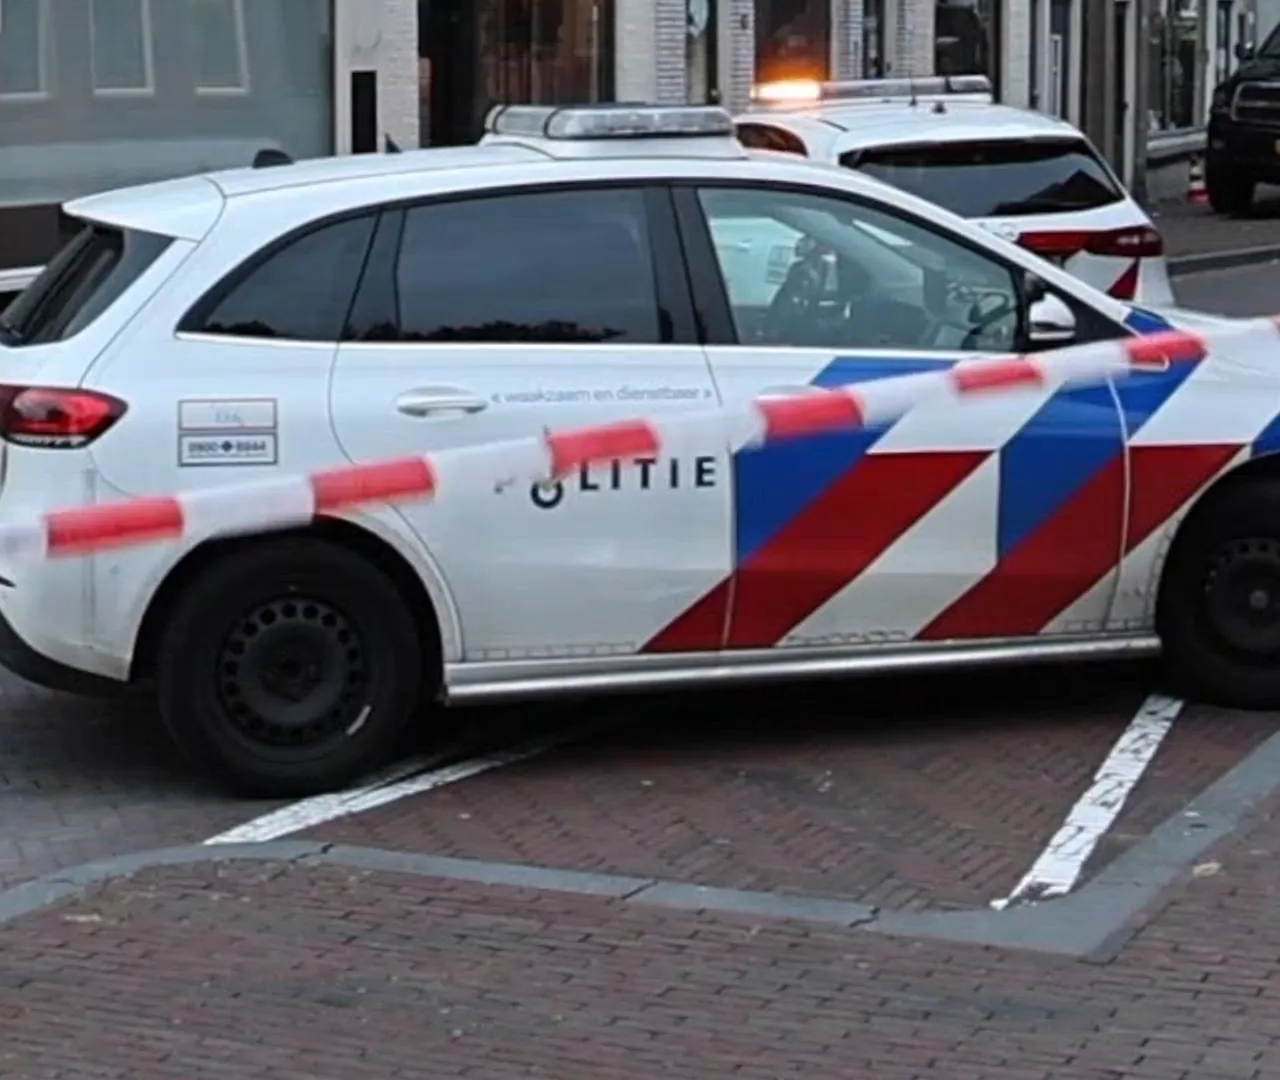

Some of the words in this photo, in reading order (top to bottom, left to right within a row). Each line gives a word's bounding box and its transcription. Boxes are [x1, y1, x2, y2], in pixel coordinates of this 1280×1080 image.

[504, 388, 591, 404] waakzaam
[593, 389, 610, 402] en
[616, 385, 700, 401] dienstbaar
[494, 455, 717, 510] OLITIE
